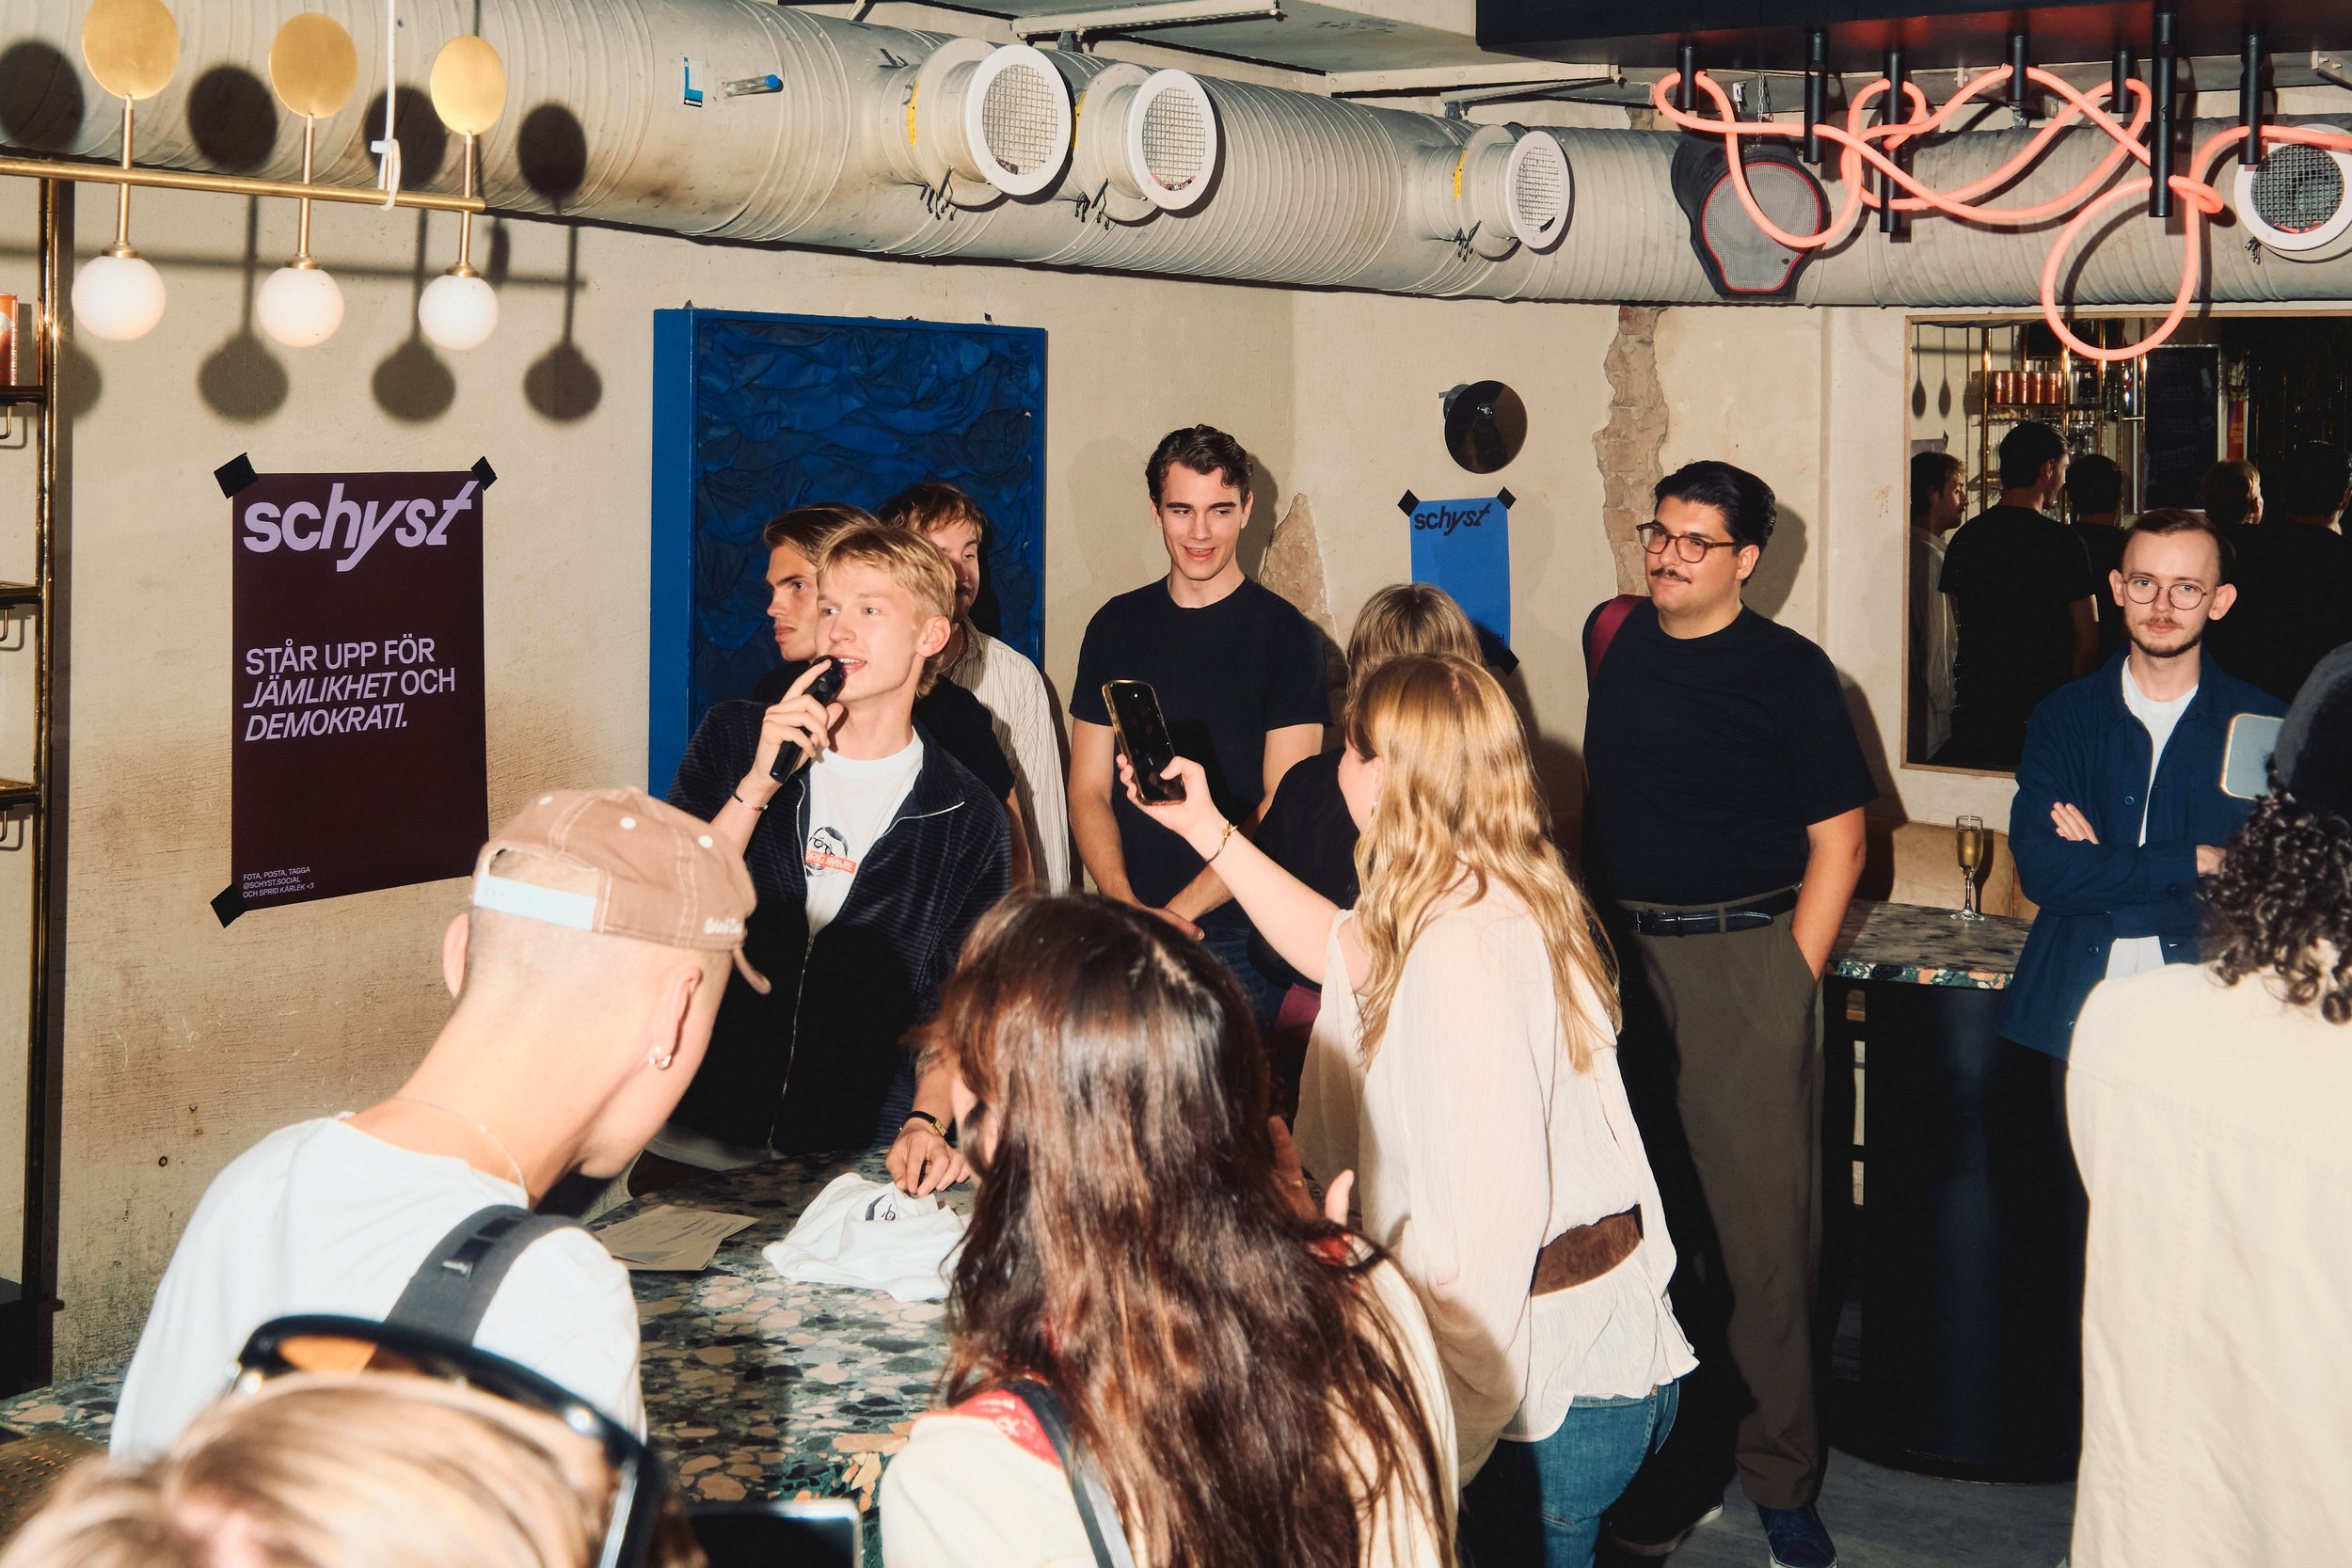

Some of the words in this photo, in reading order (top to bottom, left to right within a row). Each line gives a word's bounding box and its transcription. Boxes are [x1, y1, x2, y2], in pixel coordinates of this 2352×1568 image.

[243, 481, 480, 572] schyst
[1414, 503, 1492, 536] schyst
[246, 639, 318, 675] STÅR
[325, 641, 377, 670] UPP
[384, 633, 436, 665] FÖR
[243, 672, 398, 708] JÄMLIKHET
[400, 668, 455, 696] OCH
[245, 703, 407, 742] DEMOKRATI.
[243, 873, 262, 881] FOTA,
[263, 869, 287, 879] POSTA,
[289, 866, 310, 875] TAGGA
[243, 876, 300, 890] @SCHYST.SOCIAL
[243, 890, 258, 898] OCH
[259, 887, 278, 896] SPRID
